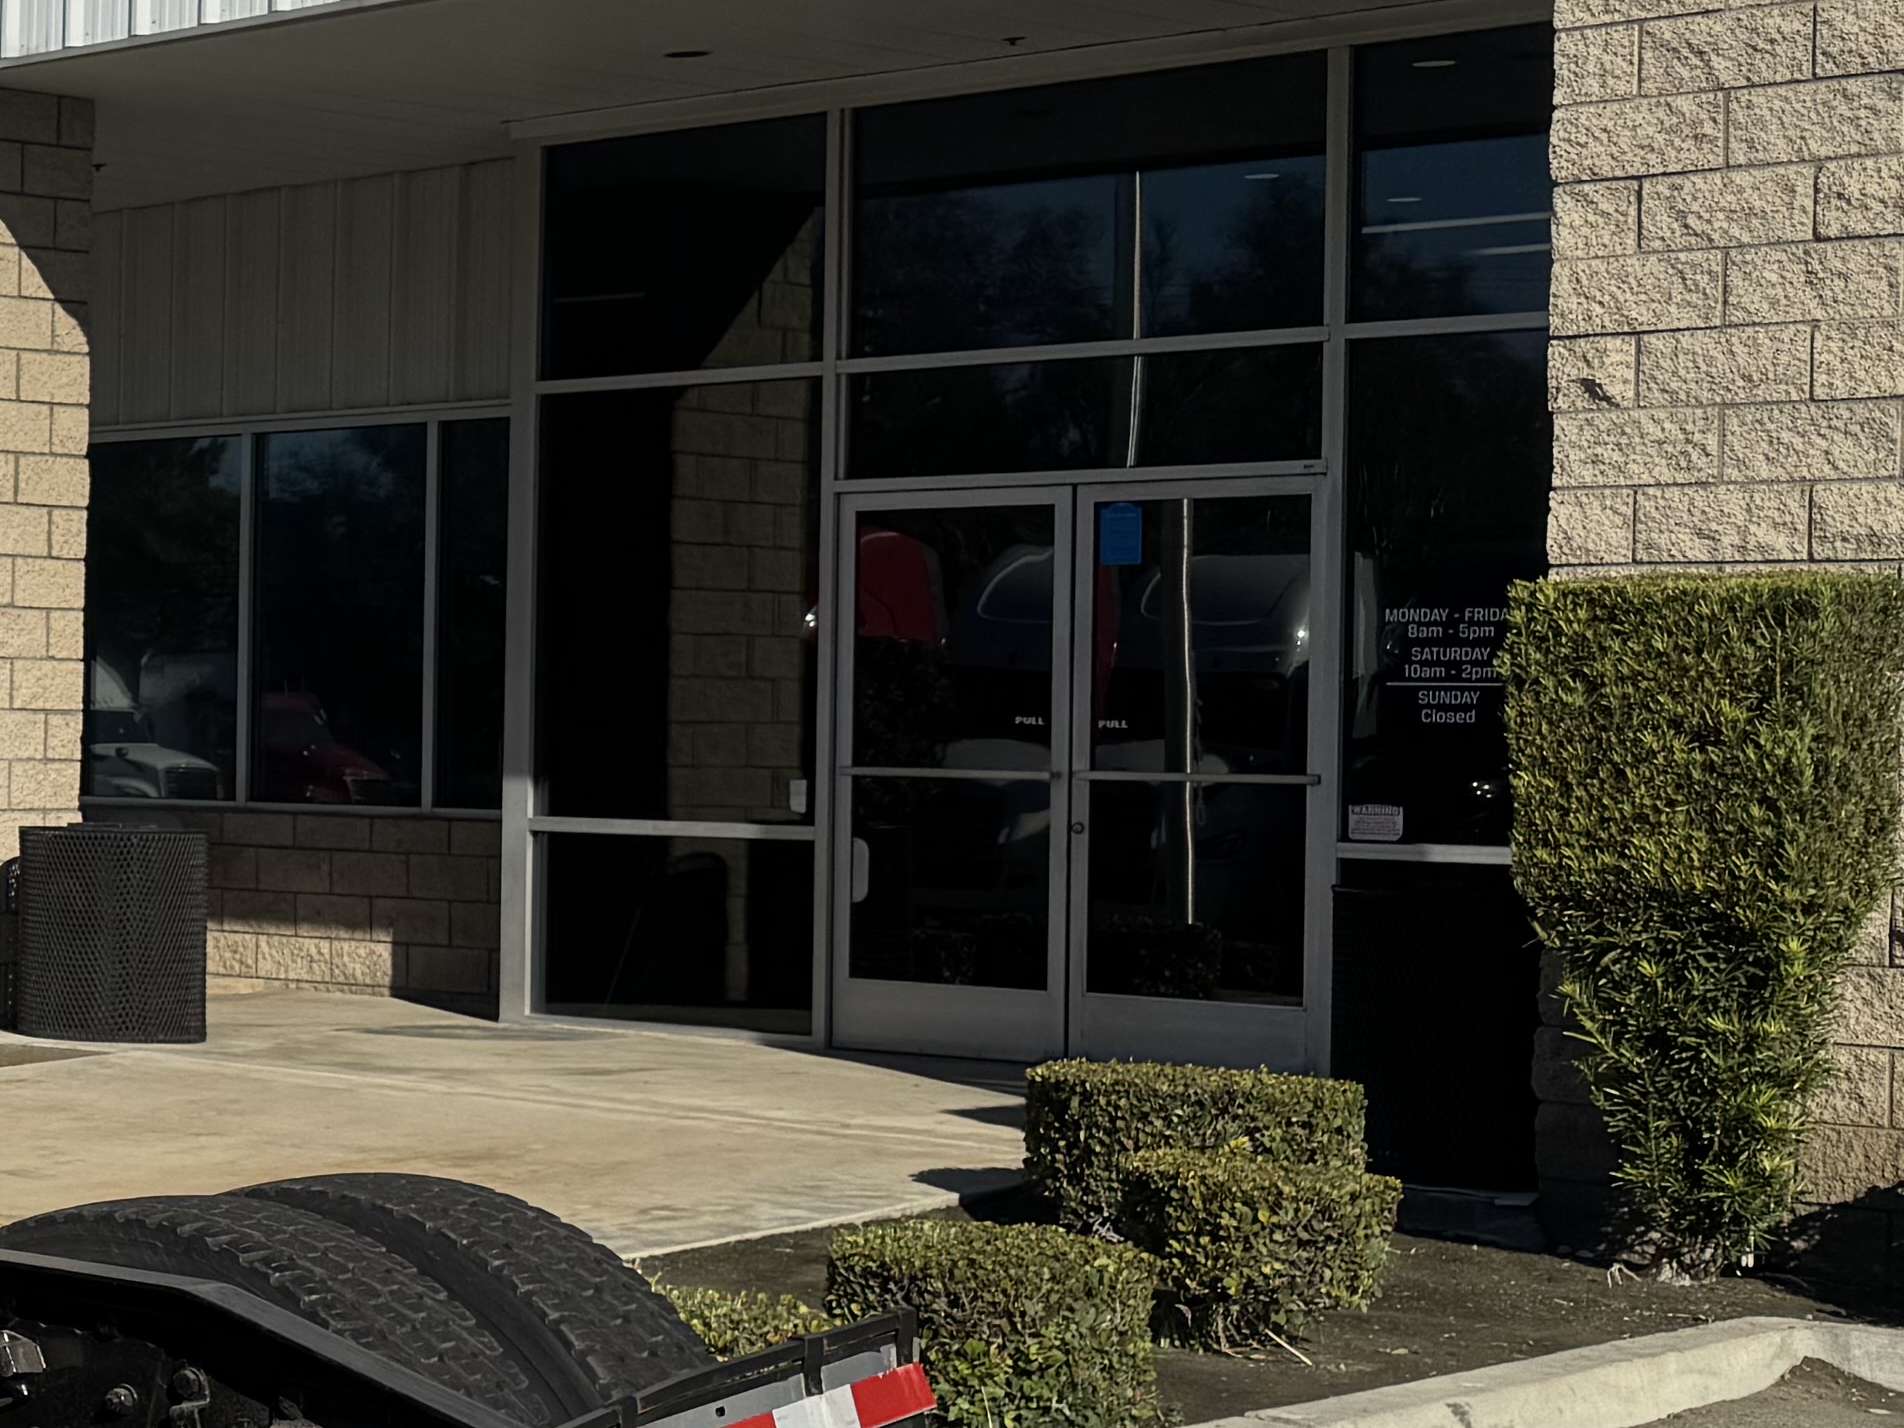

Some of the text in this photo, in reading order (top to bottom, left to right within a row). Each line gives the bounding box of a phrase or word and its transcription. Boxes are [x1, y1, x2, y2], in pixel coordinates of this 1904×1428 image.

[1385, 608, 1449, 622] MONDAY
[1465, 607, 1508, 621] FRIDA
[1408, 624, 1442, 638] 8am
[1459, 624, 1494, 640] 5pm
[1412, 647, 1490, 661] SATURDAY
[1404, 664, 1445, 678] 10am
[1462, 664, 1497, 681] 2pm
[1418, 690, 1480, 704] SUNDAY
[1015, 716, 1044, 725] PULL
[1421, 709, 1475, 723] Closed
[1098, 720, 1128, 729] PULL
